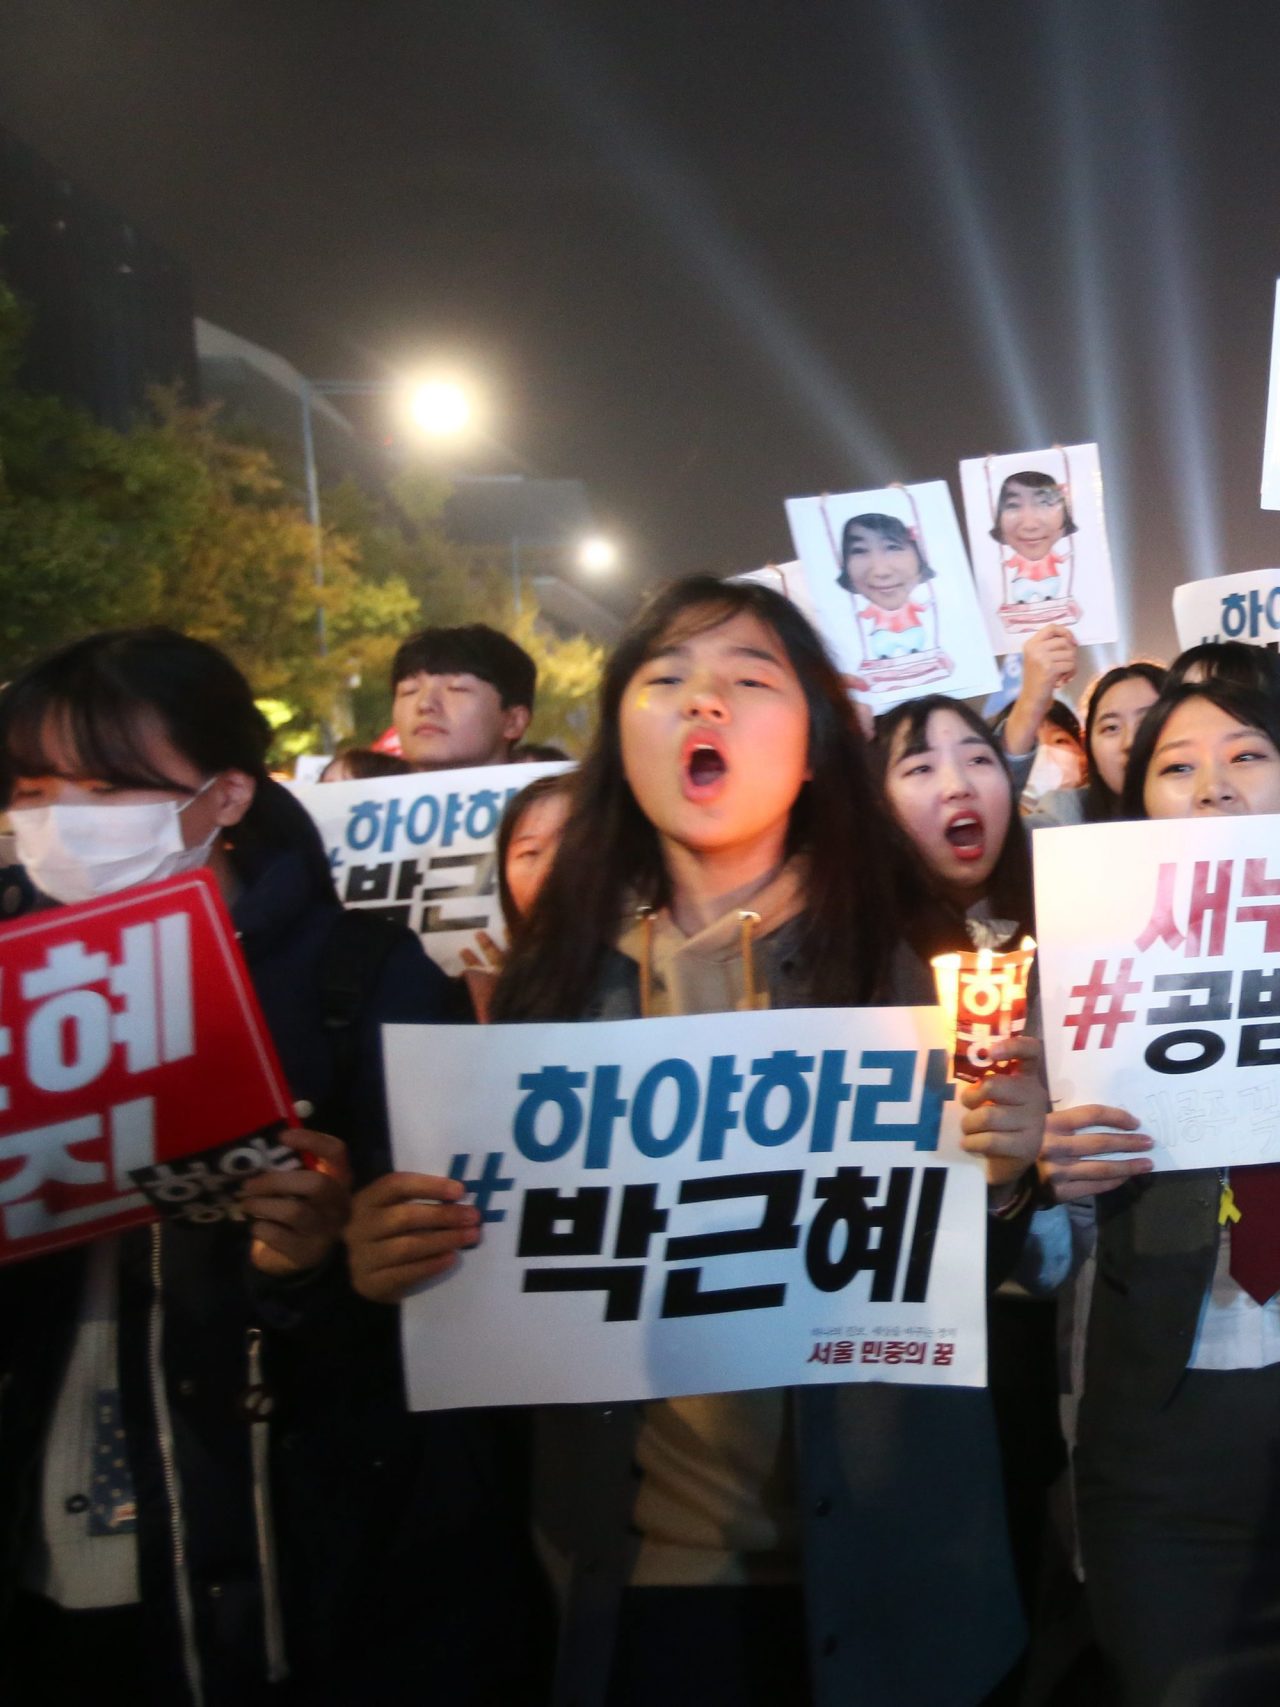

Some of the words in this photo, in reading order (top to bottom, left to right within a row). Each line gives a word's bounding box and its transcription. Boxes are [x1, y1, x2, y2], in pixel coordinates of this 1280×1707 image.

[0, 911, 197, 1110] 혜
[512, 1049, 957, 1170] 하야하라
[806, 1340, 857, 1365] 서울
[861, 1341, 928, 1365] 민중의
[932, 1343, 955, 1366] 꿈
